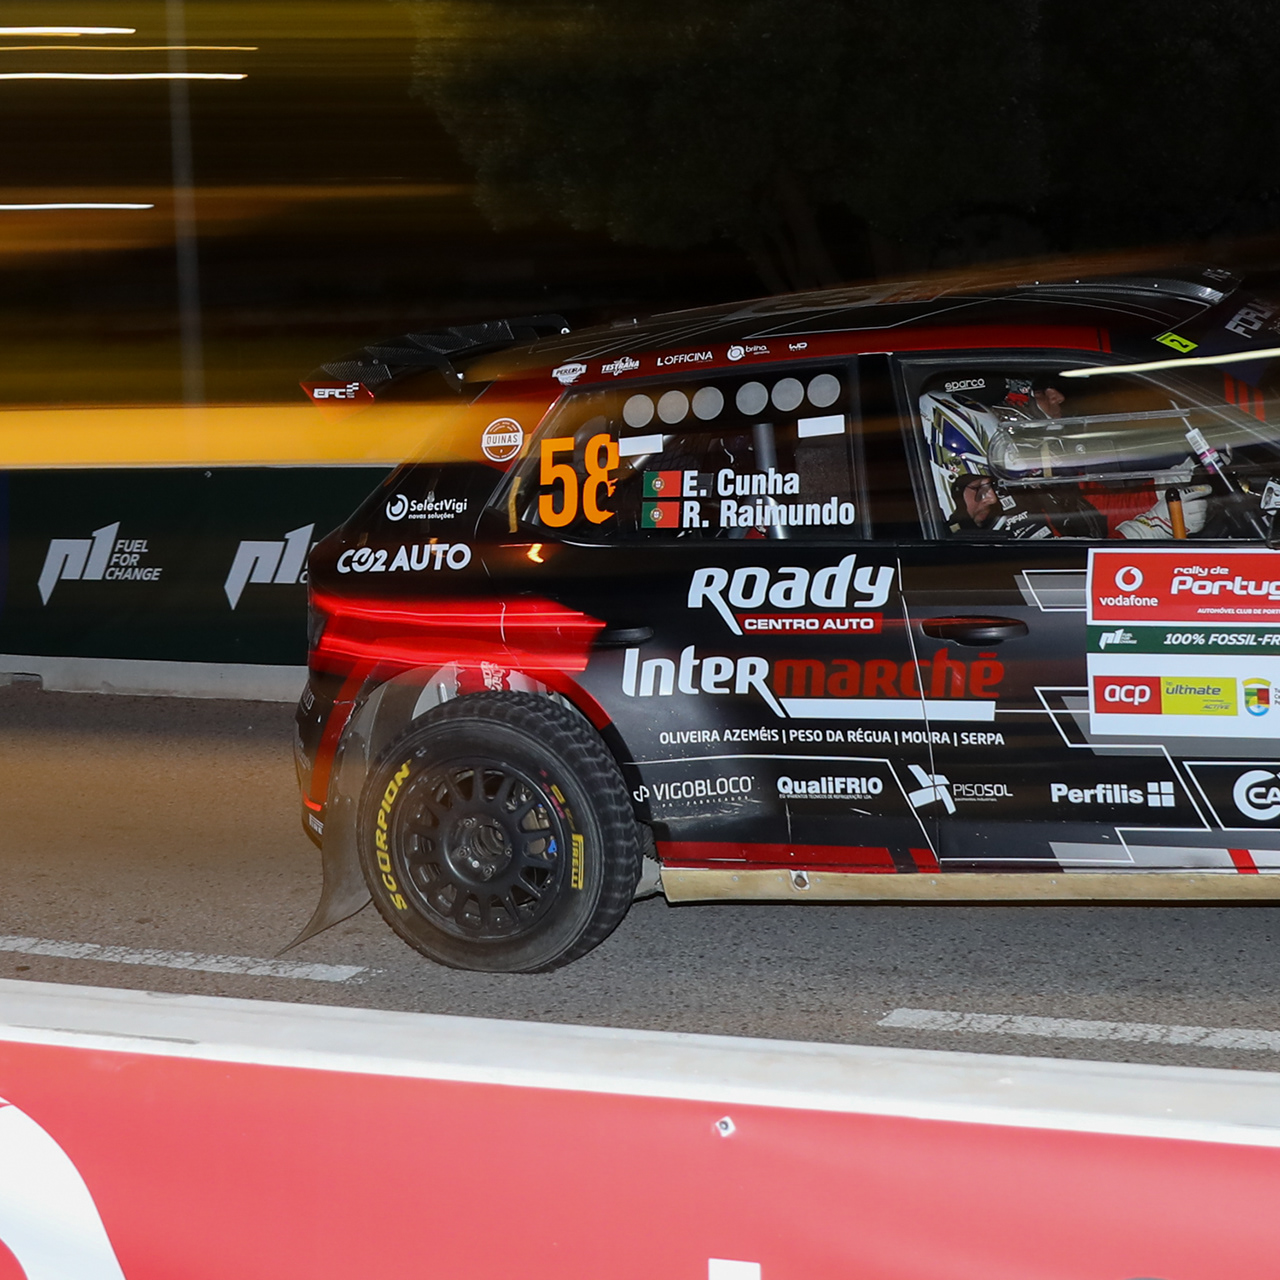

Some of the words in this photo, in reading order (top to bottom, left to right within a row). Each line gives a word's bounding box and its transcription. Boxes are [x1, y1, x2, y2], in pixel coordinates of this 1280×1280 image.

[944, 378, 985, 391] sparco
[313, 388, 346, 398] EFC
[538, 433, 619, 527] 58
[682, 469, 707, 497] E.
[717, 467, 800, 496] Cunha
[410, 497, 467, 513] SelectVigi
[682, 500, 710, 528] R.
[720, 496, 856, 527] Raimundo
[428, 511, 454, 520] soluções
[114, 539, 149, 553] FUEL
[111, 554, 139, 567] FOR
[389, 542, 472, 572] AUTO
[105, 568, 162, 581] CHANGE
[1173, 566, 1208, 576] rally
[1210, 566, 1229, 575] de
[1099, 595, 1158, 607] vodafone
[743, 618, 820, 630] CENTRO
[822, 618, 874, 630] AUTO
[1163, 632, 1205, 646] 100%
[1104, 683, 1151, 706] acp
[1165, 684, 1221, 696] ultimate
[659, 730, 720, 745] OLIVEIRA
[723, 726, 779, 743] AZEMÉIS
[789, 729, 823, 743] PESO
[826, 729, 845, 743] DA
[847, 726, 890, 744] RÉGUA
[901, 730, 950, 745] MOURA
[961, 731, 1005, 746] SERPA
[653, 775, 753, 802] VIGOBLOCO
[776, 775, 883, 795] QualiFRIO
[952, 783, 1014, 797] PISOSOL
[1050, 782, 1144, 804] Perfilis
[375, 759, 411, 911] SCORPION
[571, 833, 584, 890] PIRELLI
